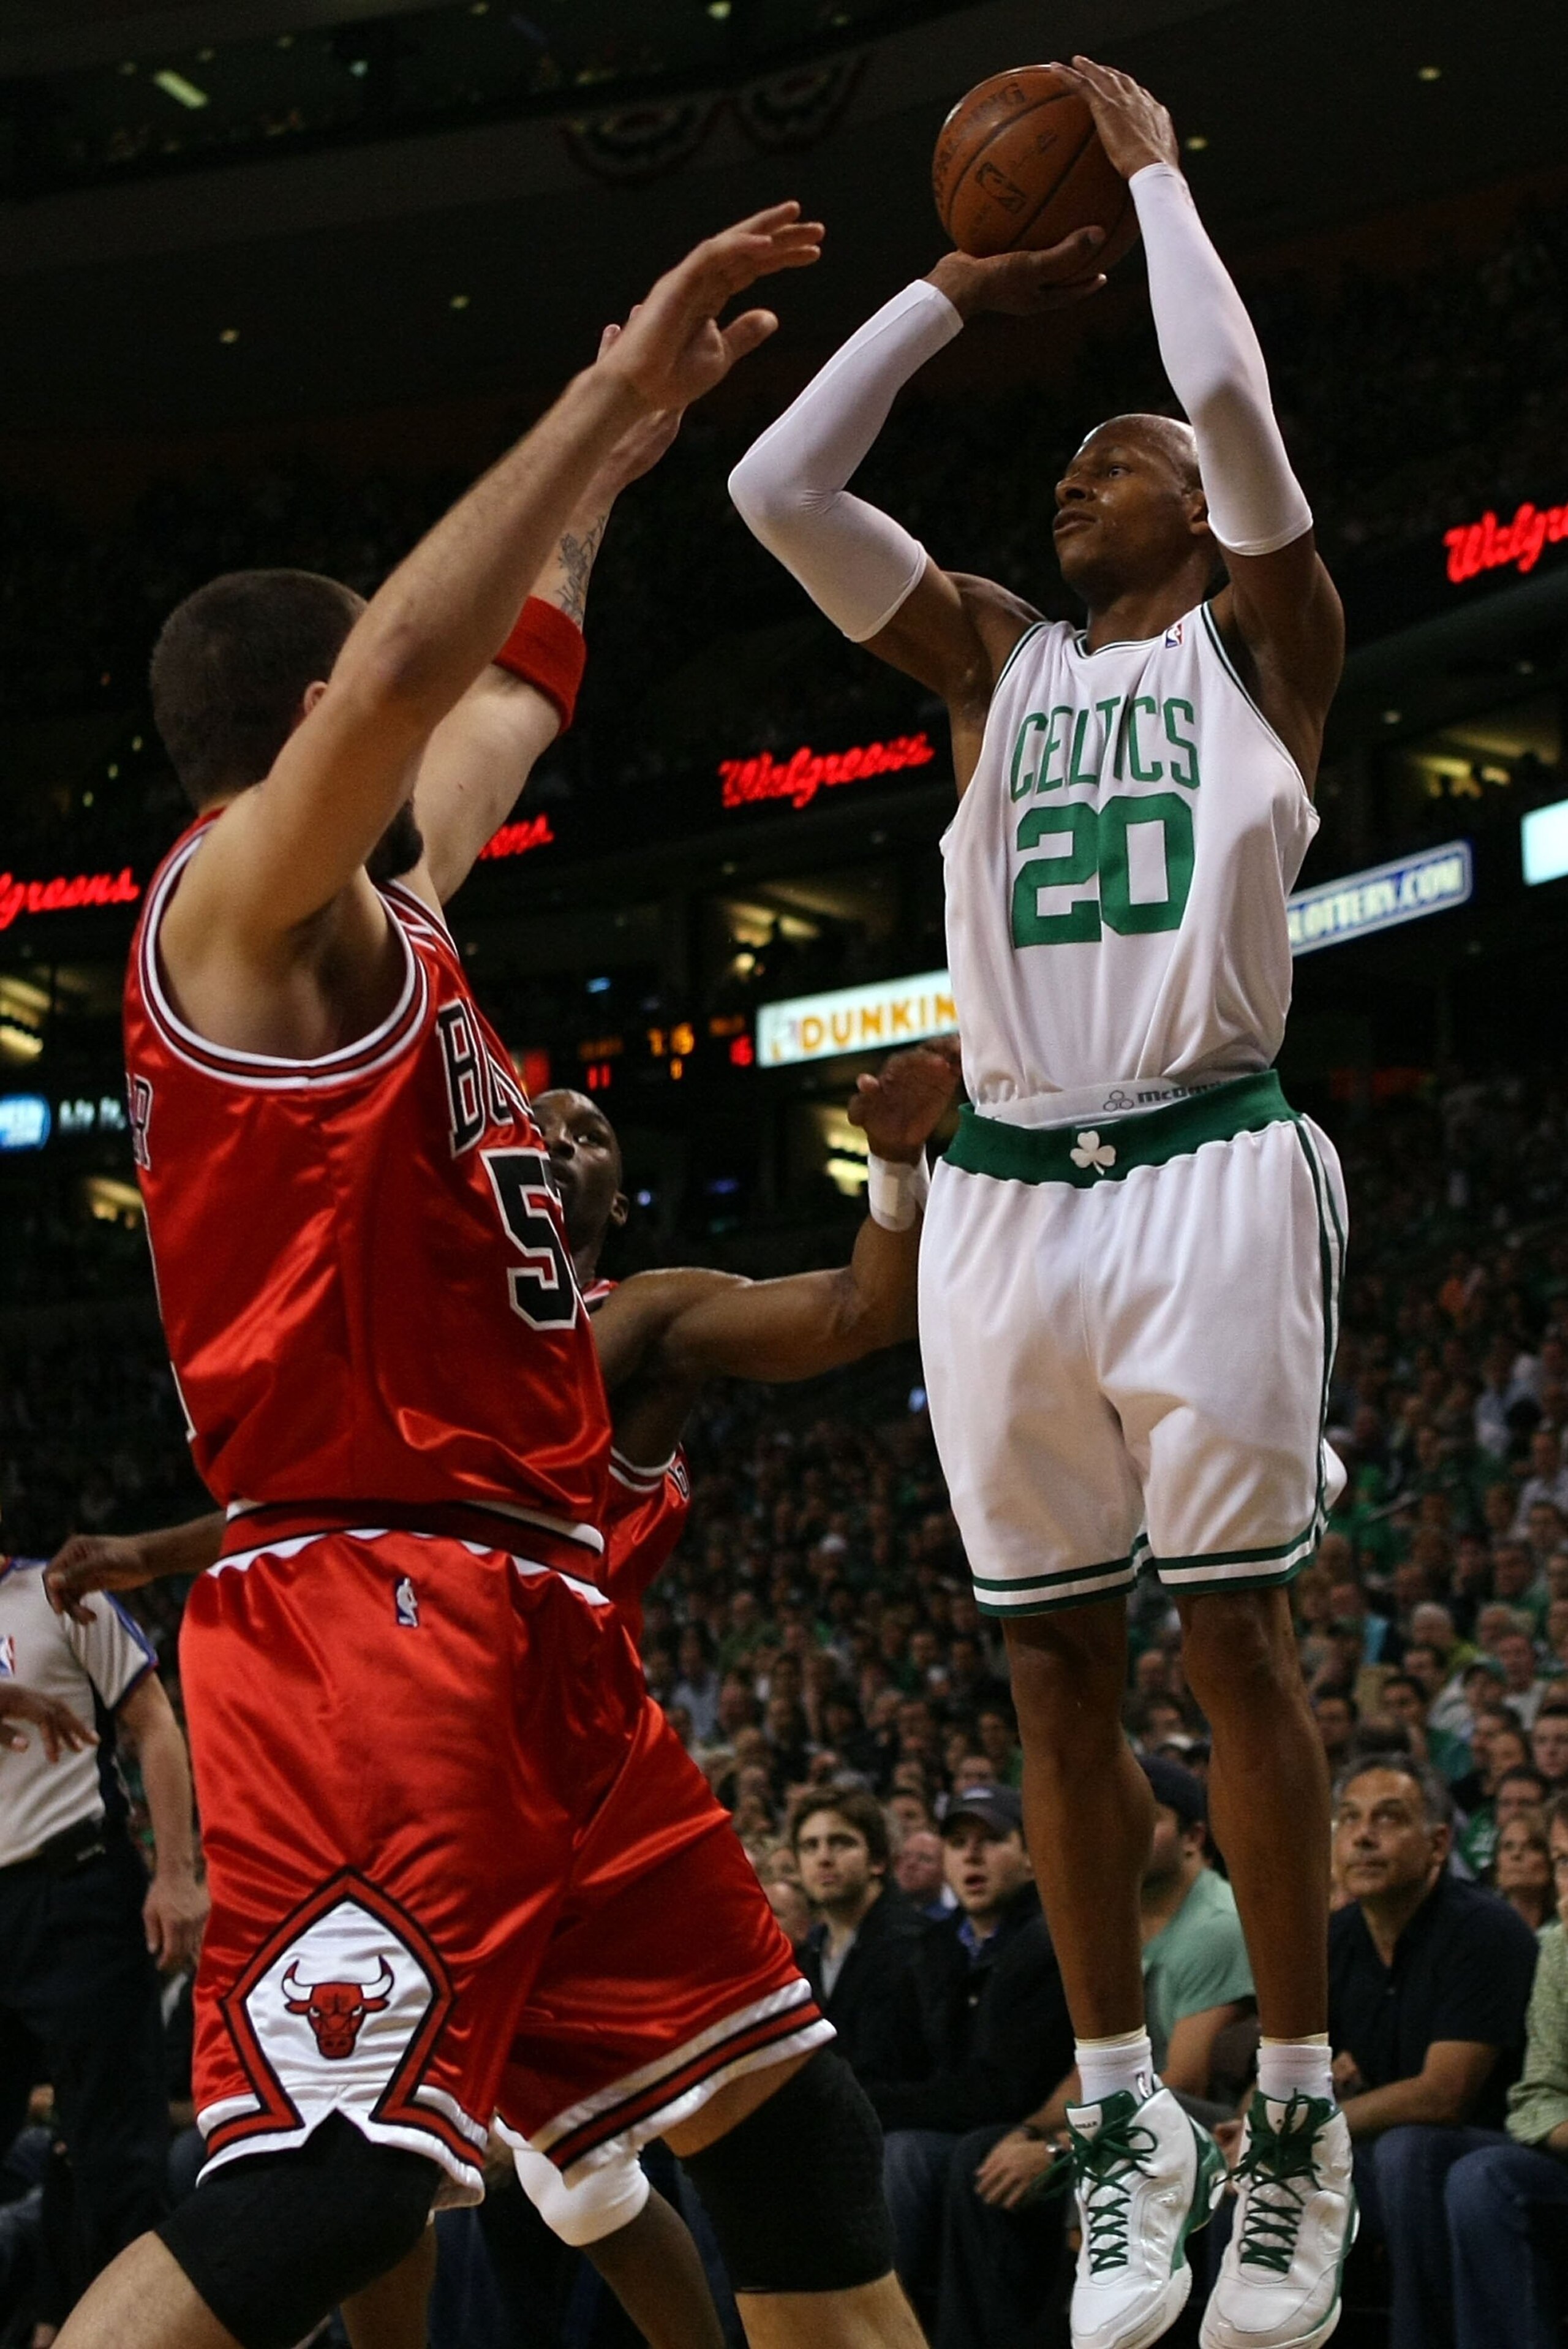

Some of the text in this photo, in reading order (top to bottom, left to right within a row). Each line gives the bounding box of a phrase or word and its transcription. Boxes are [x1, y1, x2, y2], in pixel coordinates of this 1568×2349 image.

[1443, 503, 1568, 583] Walgr
[719, 732, 934, 809] Walgreens
[1012, 792, 1195, 948] 20
[479, 1146, 589, 1330] 5
